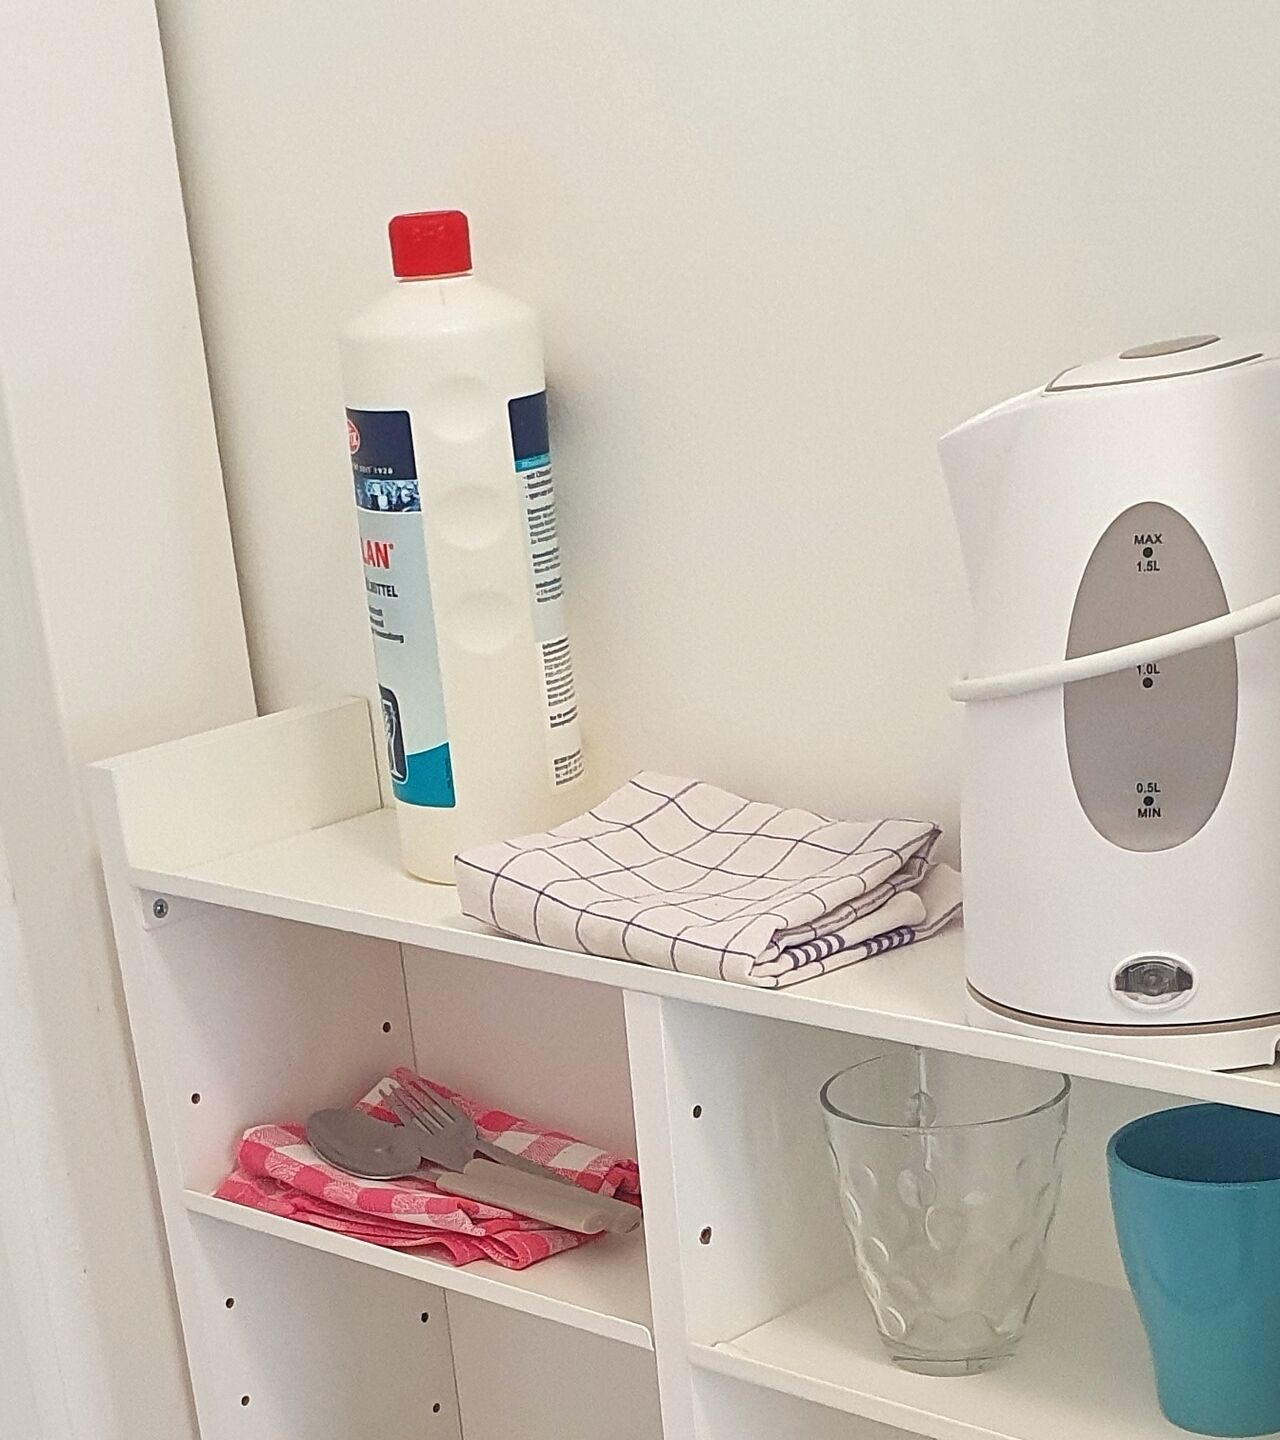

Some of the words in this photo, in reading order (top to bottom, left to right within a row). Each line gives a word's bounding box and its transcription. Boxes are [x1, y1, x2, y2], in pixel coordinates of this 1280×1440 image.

[1134, 535, 1163, 545] MAX
[1136, 560, 1160, 572] 1.5L
[1136, 664, 1160, 676] 1.0L
[1136, 782, 1161, 794] 0.5L
[1137, 808, 1162, 819] MIN
